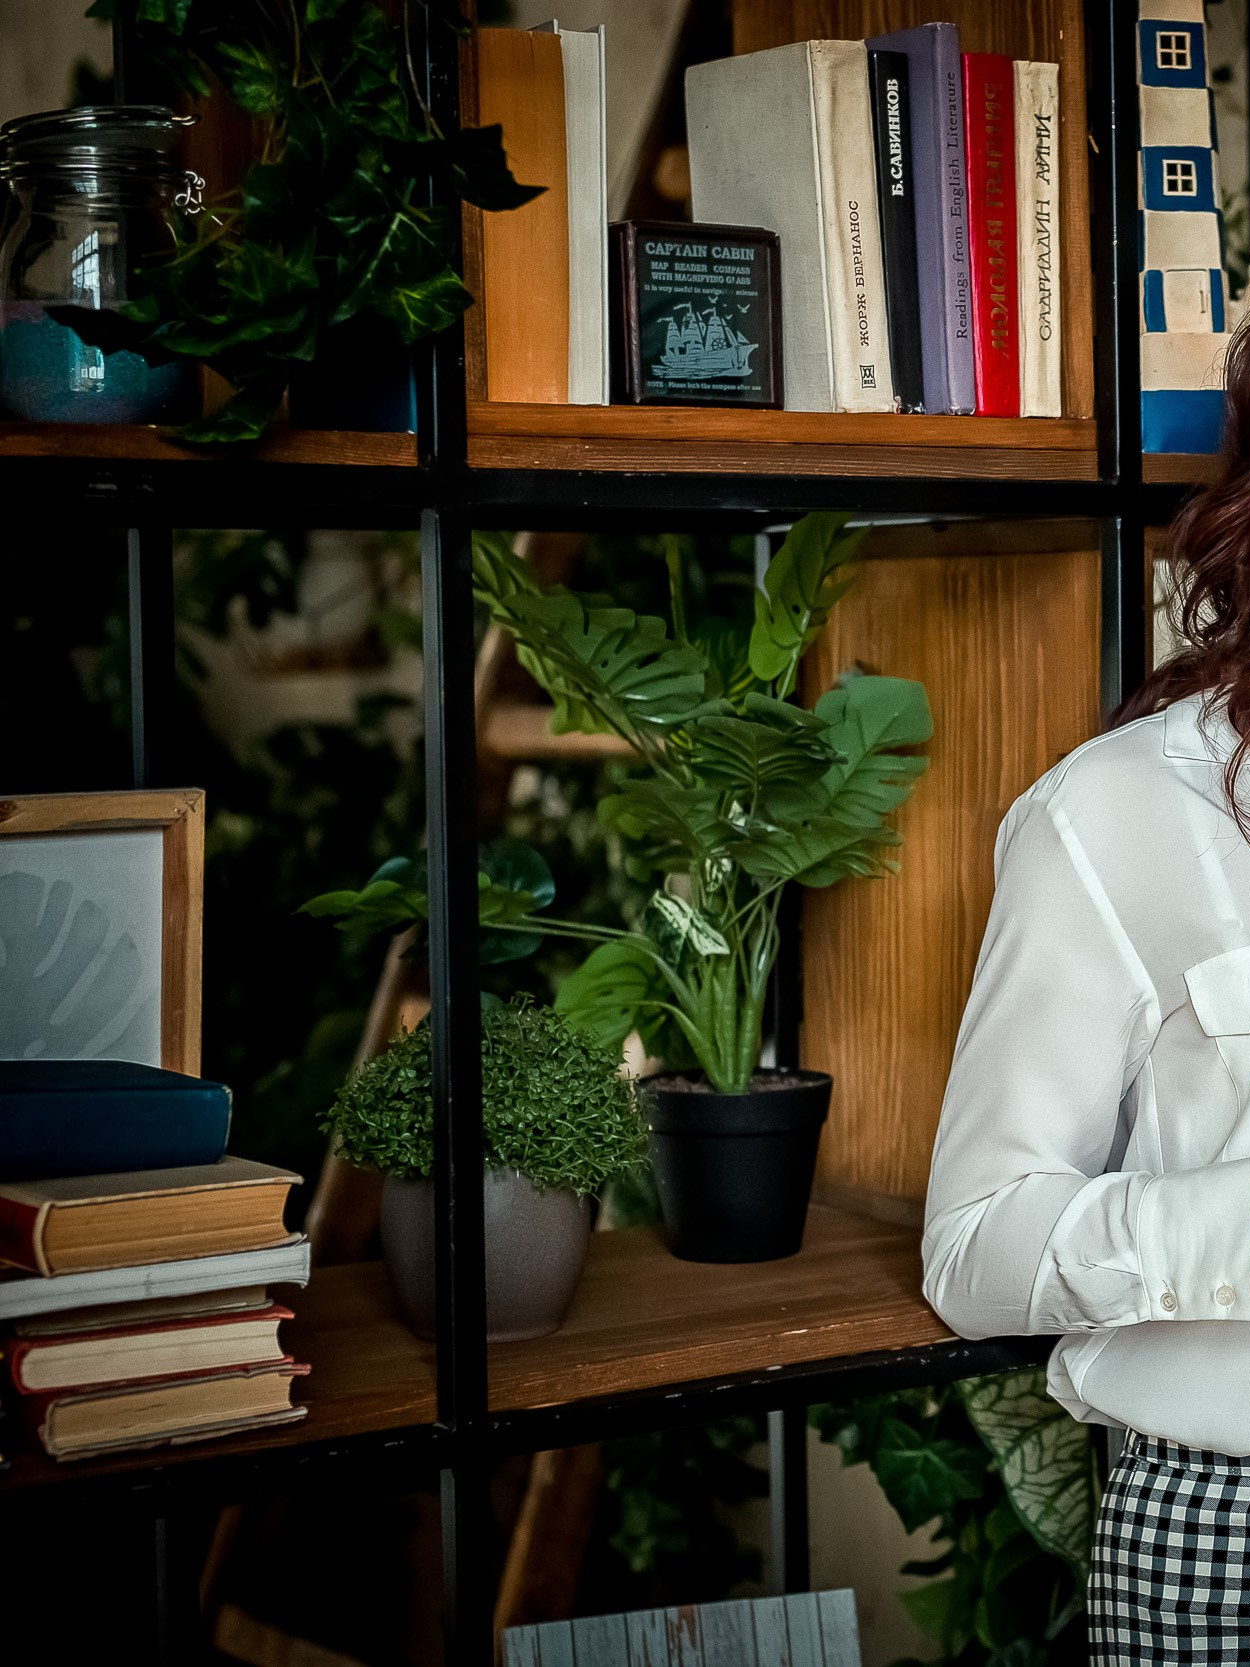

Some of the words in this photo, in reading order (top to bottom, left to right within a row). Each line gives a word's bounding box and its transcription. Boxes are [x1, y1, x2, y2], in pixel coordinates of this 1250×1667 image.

[886, 78, 904, 197] Б.САВИНКОВ
[946, 71, 959, 149] Literature
[949, 158, 963, 218] English
[645, 242, 708, 257] CAPTAIN
[711, 246, 755, 260] CABIN
[651, 261, 669, 270] MAP
[674, 262, 708, 272] READER
[713, 265, 751, 274] COMPASS
[848, 200, 865, 287] БЕРНАНОС
[952, 226, 965, 263] from
[1035, 199, 1052, 341] САДРИДДИН
[651, 272, 673, 280] WITH
[674, 273, 724, 284] MAGNIFYING
[726, 276, 751, 285] GLASS
[658, 285, 672, 293] very
[955, 271, 968, 340] Readings
[986, 219, 1009, 359] МОЛОДАЯ
[857, 293, 869, 347] ЖОРЖ
[668, 381, 686, 389] Please
